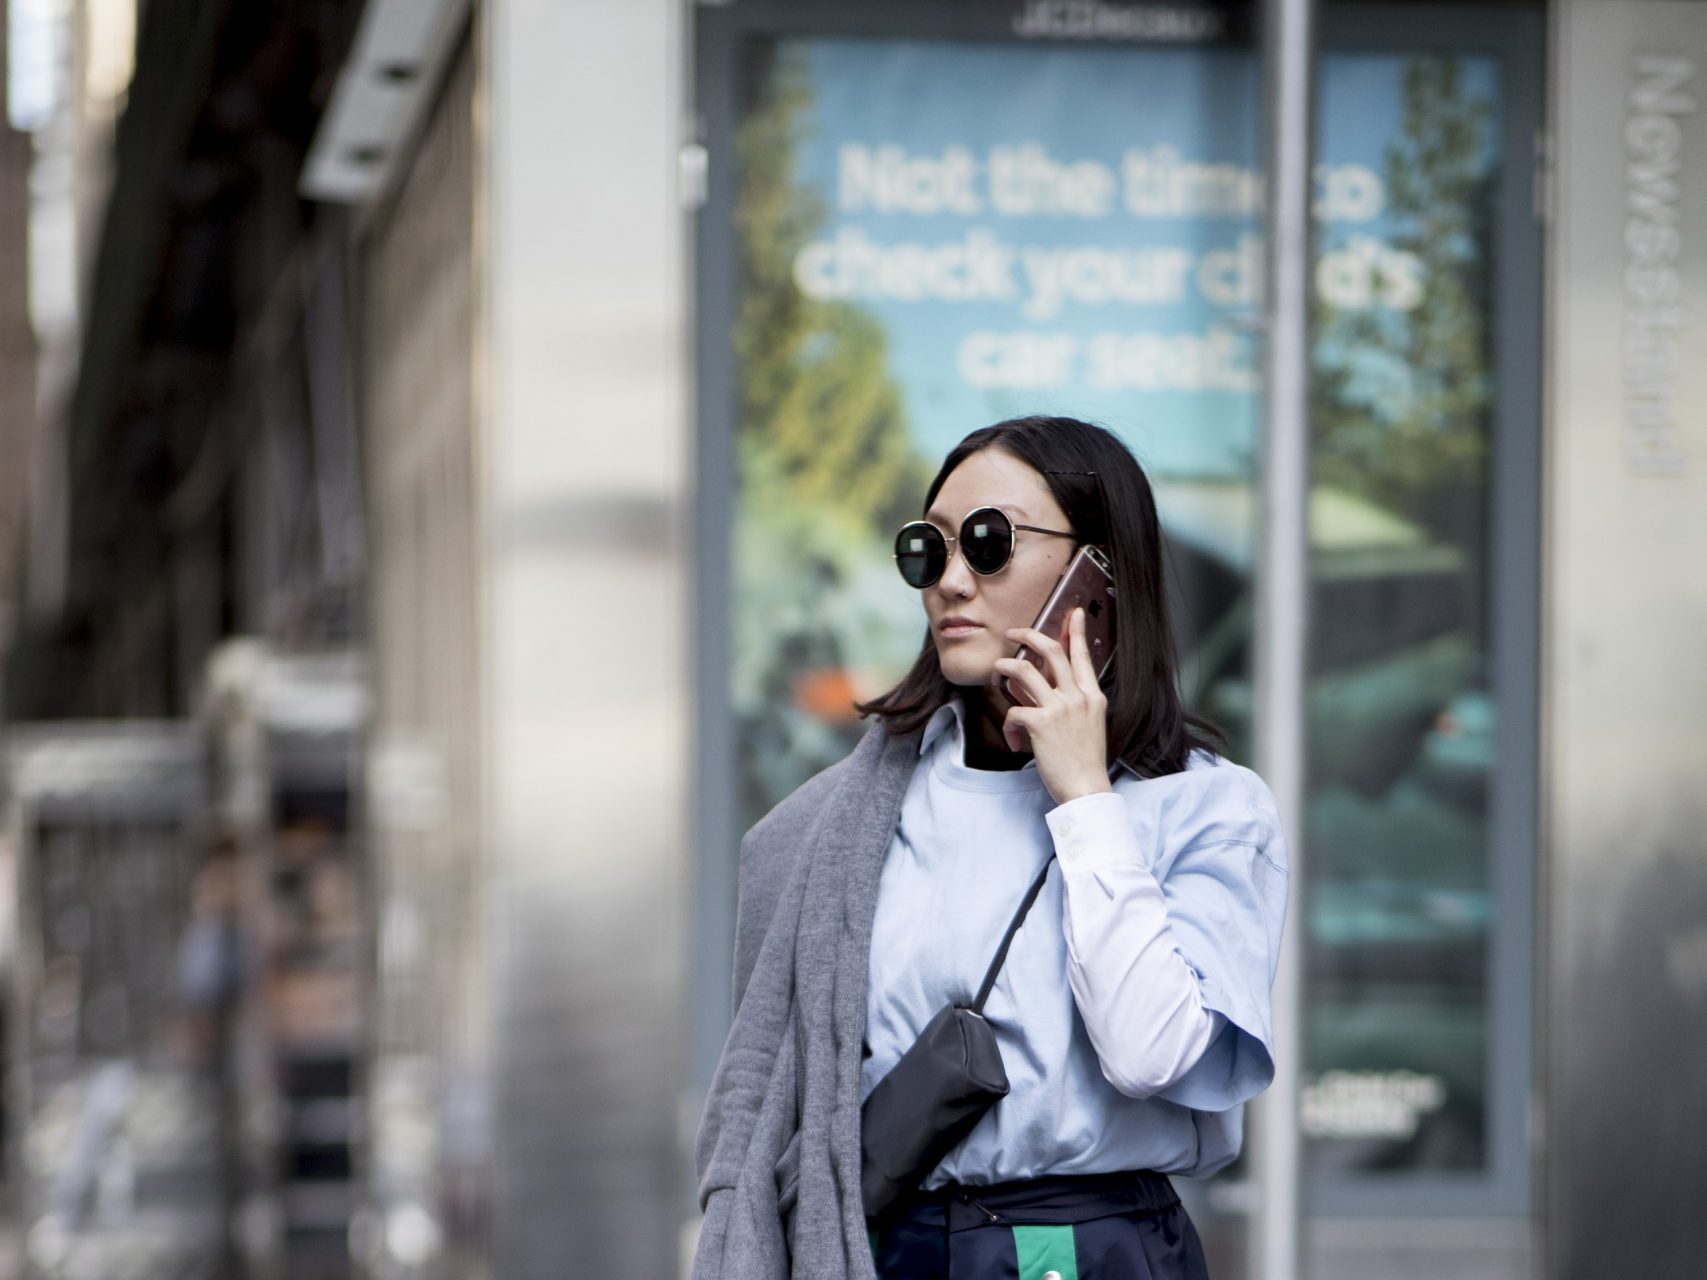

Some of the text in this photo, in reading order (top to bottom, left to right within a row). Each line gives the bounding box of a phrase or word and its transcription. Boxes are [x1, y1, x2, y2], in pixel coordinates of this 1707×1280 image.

[838, 145, 979, 214] Not
[989, 145, 1113, 216] the
[1122, 146, 1268, 217] tim
[794, 229, 1016, 302] check
[1020, 247, 1188, 319] your
[958, 332, 1076, 388] car
